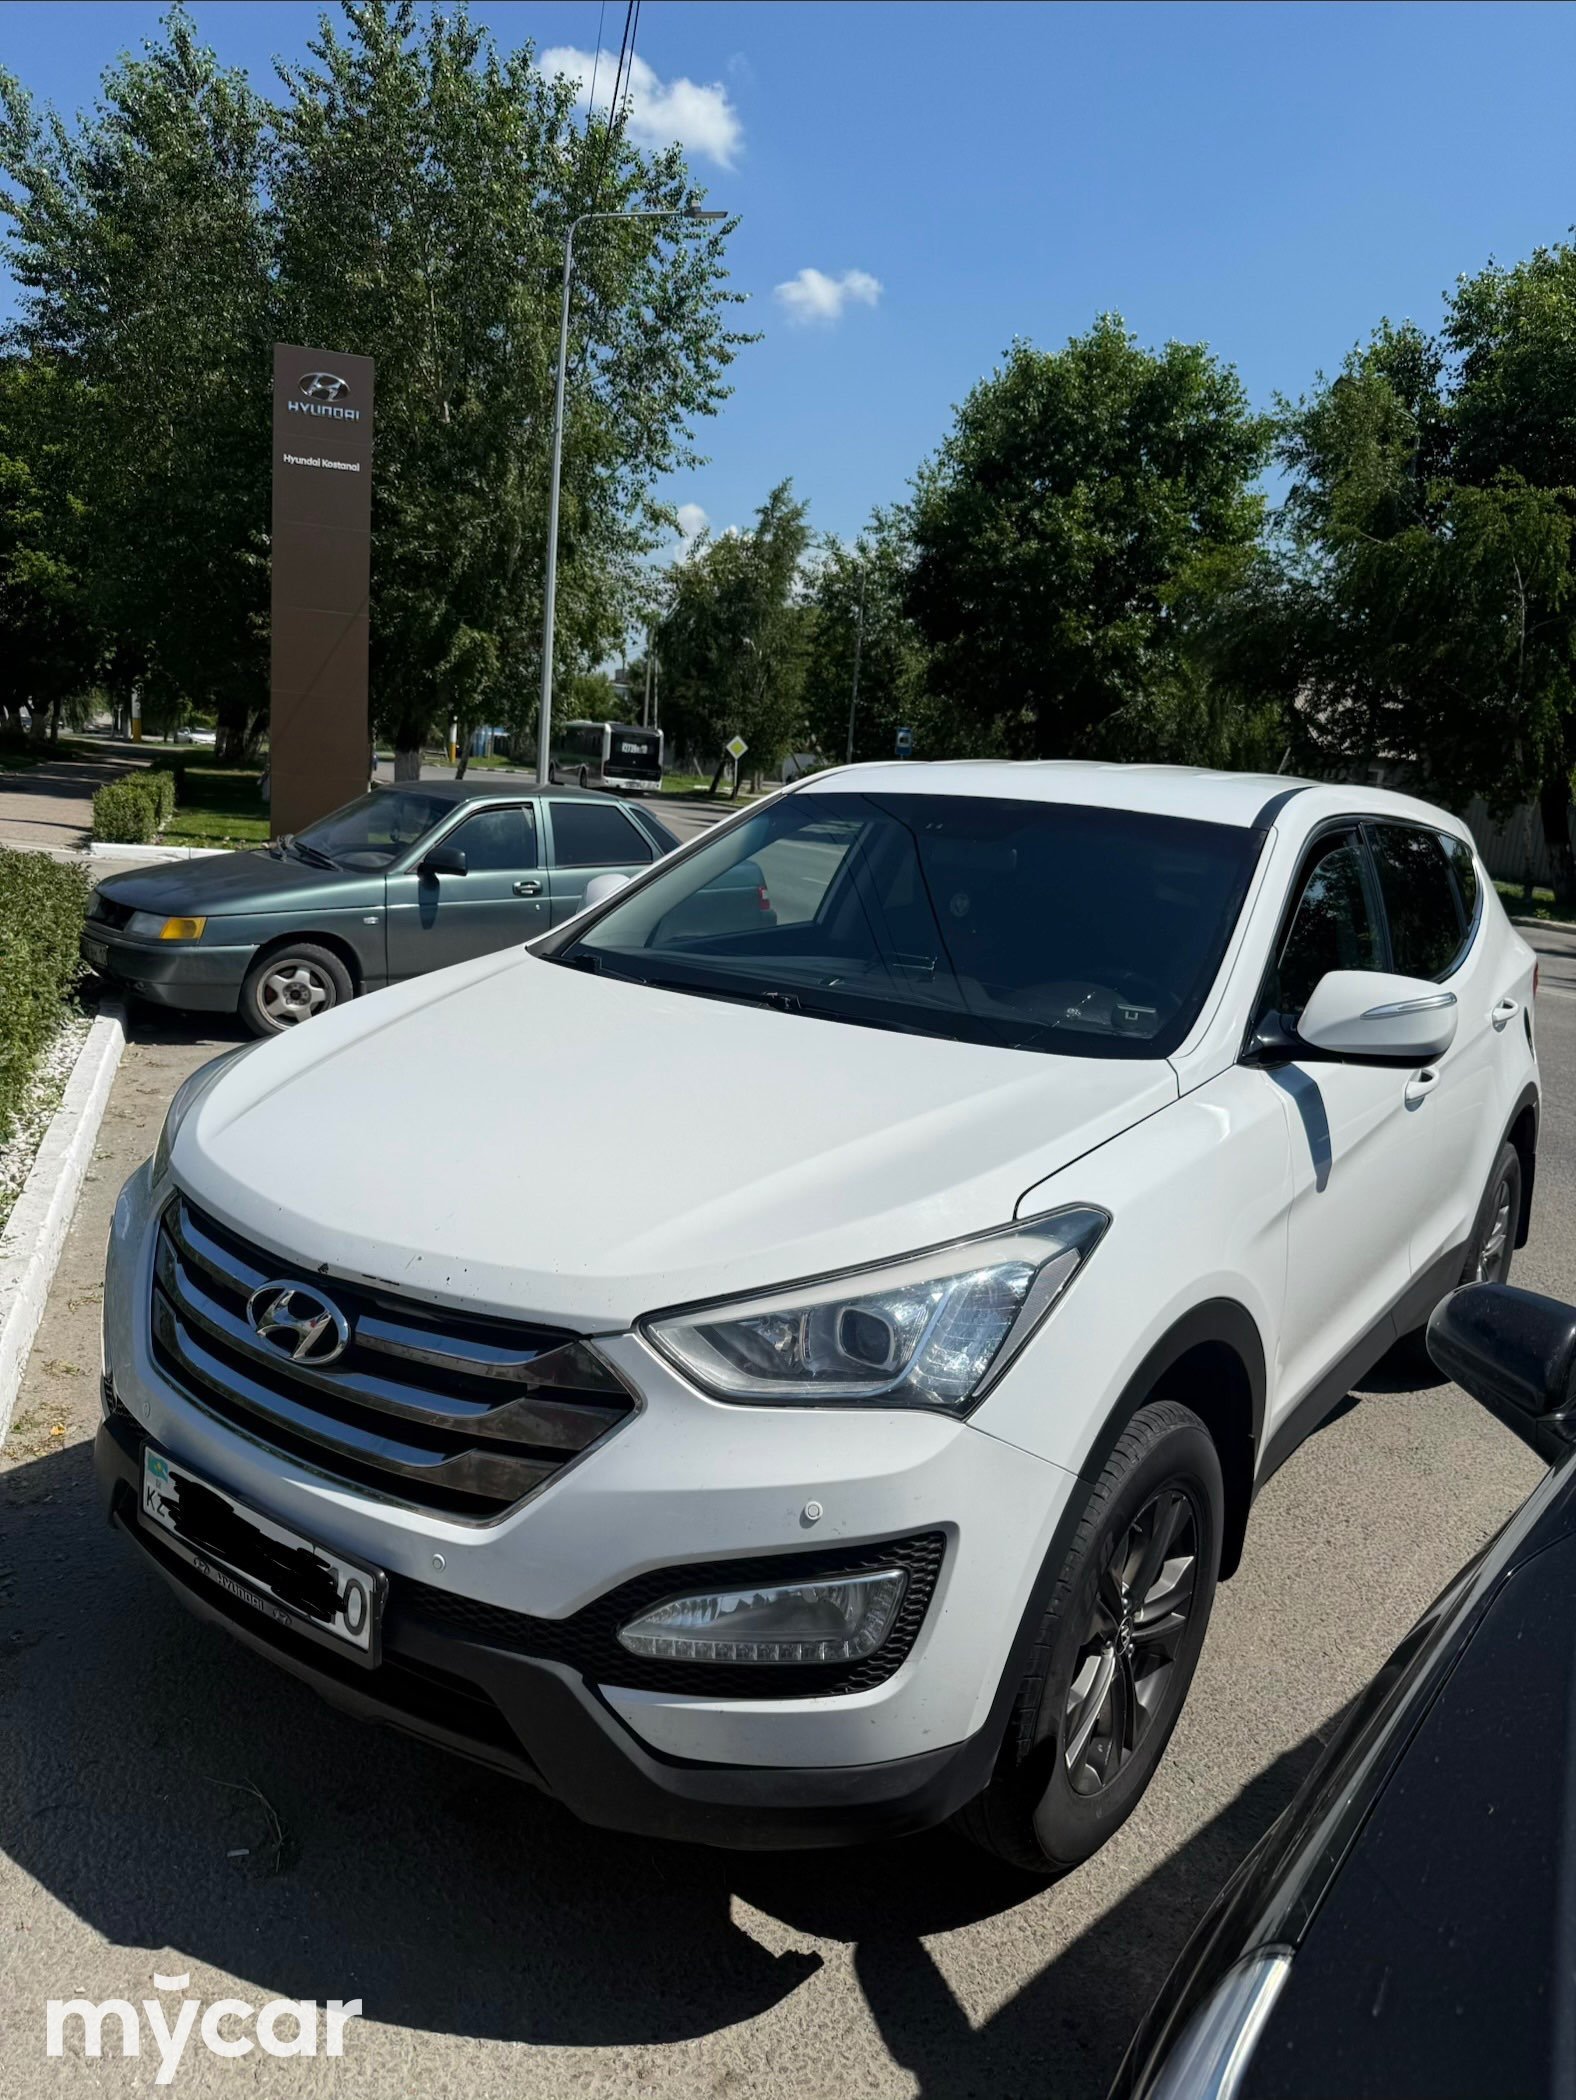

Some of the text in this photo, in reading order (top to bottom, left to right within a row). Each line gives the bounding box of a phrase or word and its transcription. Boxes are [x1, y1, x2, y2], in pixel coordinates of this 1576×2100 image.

[288, 400, 360, 421] HYUNDAI
[283, 454, 360, 472] Hyundai Kostanai
[217, 1572, 264, 1611] HYUNDAI
